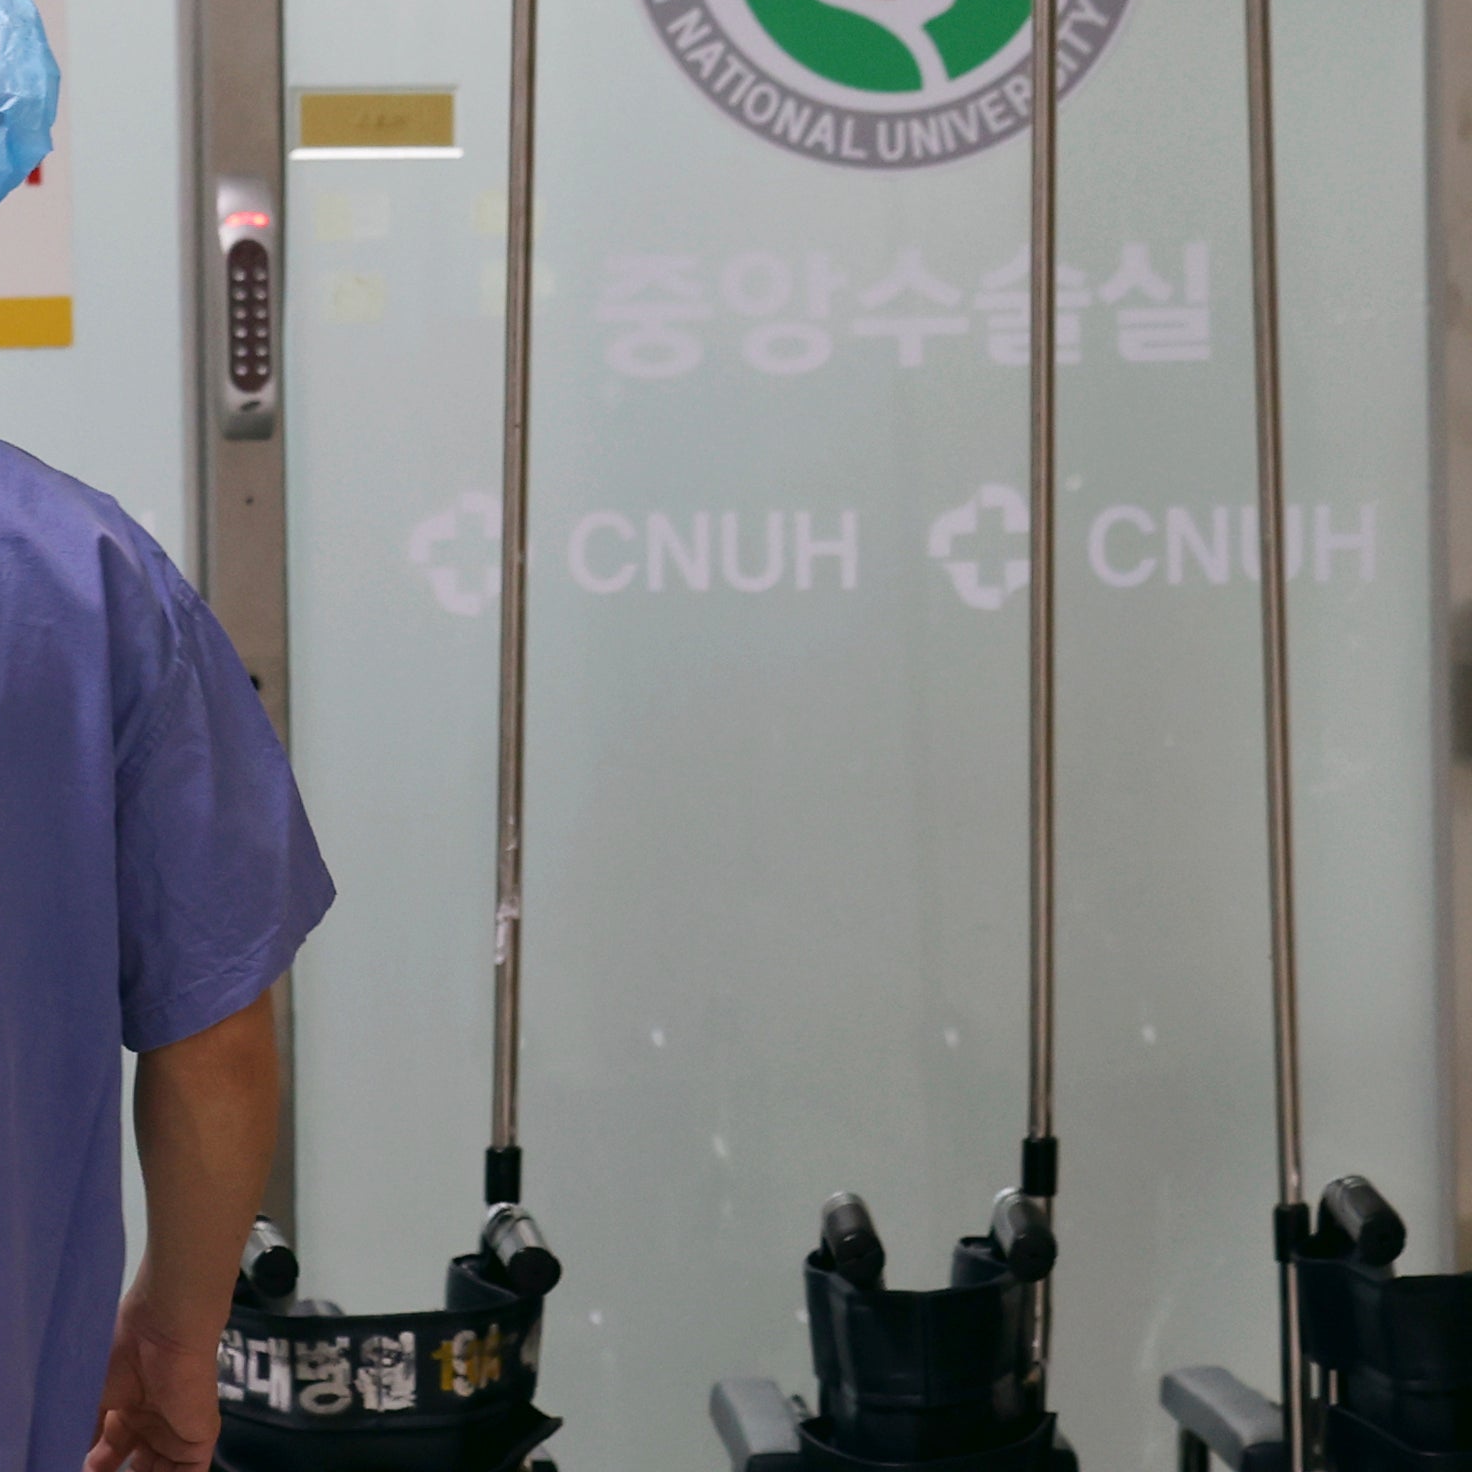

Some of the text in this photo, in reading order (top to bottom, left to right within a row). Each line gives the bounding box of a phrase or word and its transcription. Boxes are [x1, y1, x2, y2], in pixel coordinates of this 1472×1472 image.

[666, 9, 867, 159] NATIONAL
[591, 241, 1213, 380] 중앙수술실
[567, 509, 858, 595] CNUH
[1087, 504, 1378, 588] CNUH
